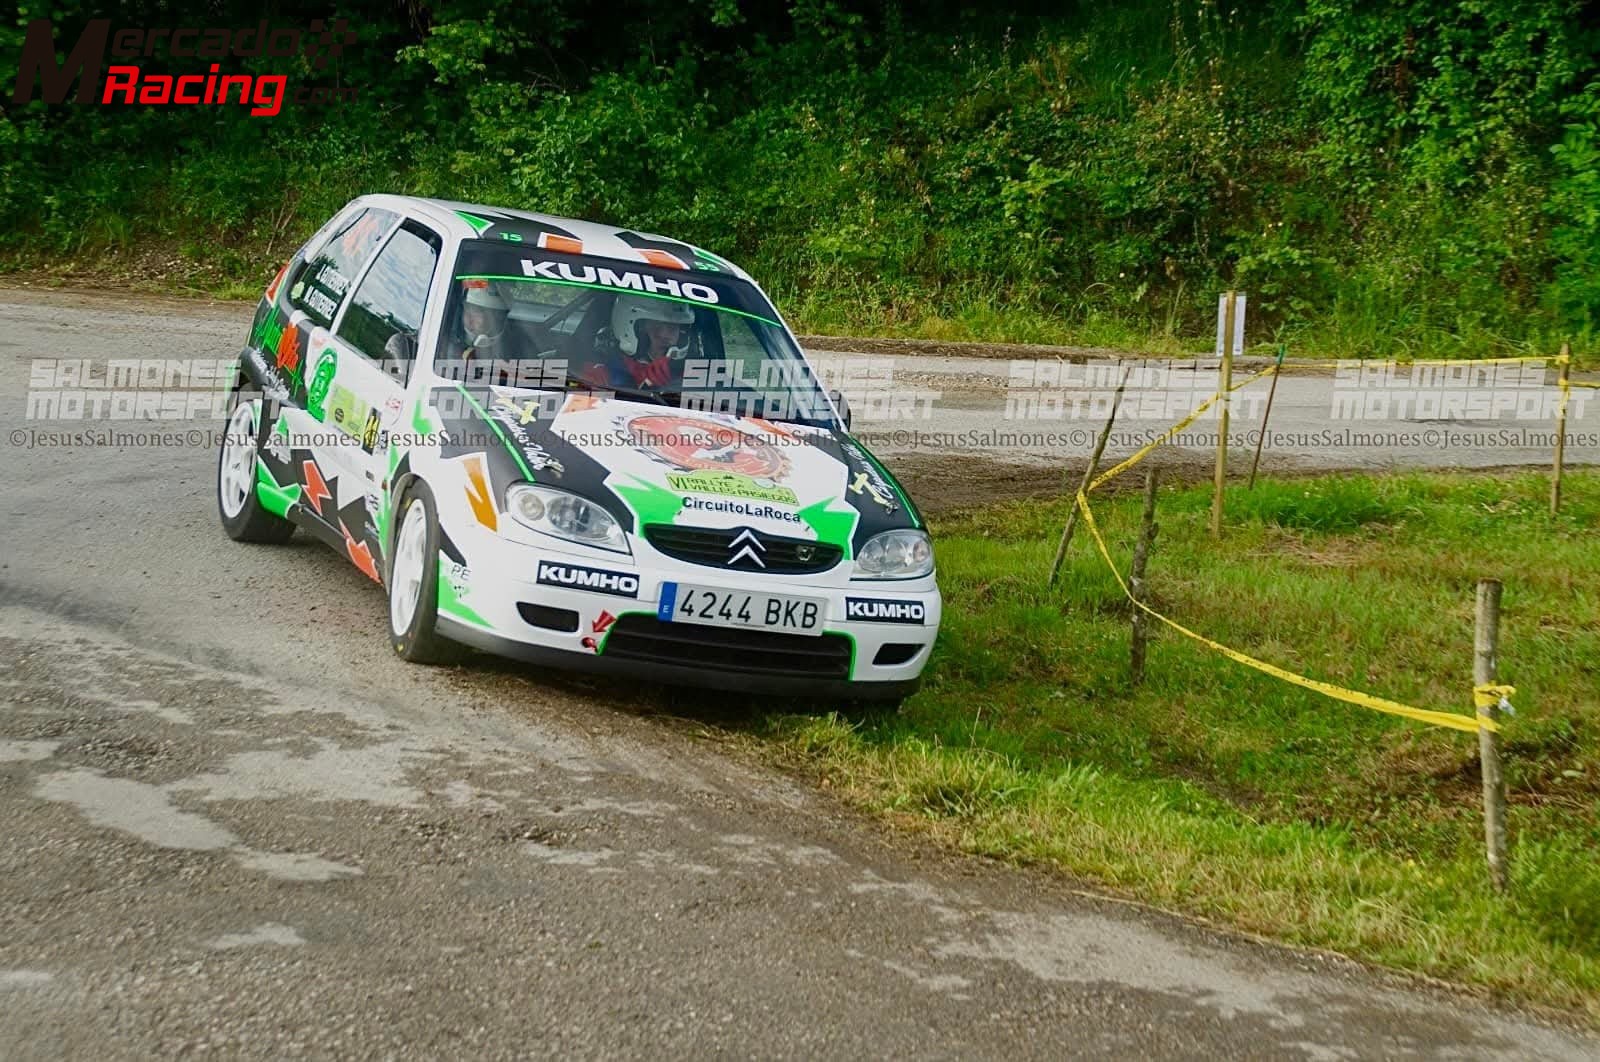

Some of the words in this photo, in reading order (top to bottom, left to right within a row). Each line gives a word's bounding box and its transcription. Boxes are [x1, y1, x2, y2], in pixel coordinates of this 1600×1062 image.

[520, 259, 719, 304] KUMHO
[682, 496, 801, 523] CircuitoLaRoca
[539, 565, 639, 593] KUMHO
[663, 605, 670, 614] E
[680, 589, 752, 624] 4244
[765, 598, 818, 629] BKB
[848, 602, 924, 620] KUMHO
